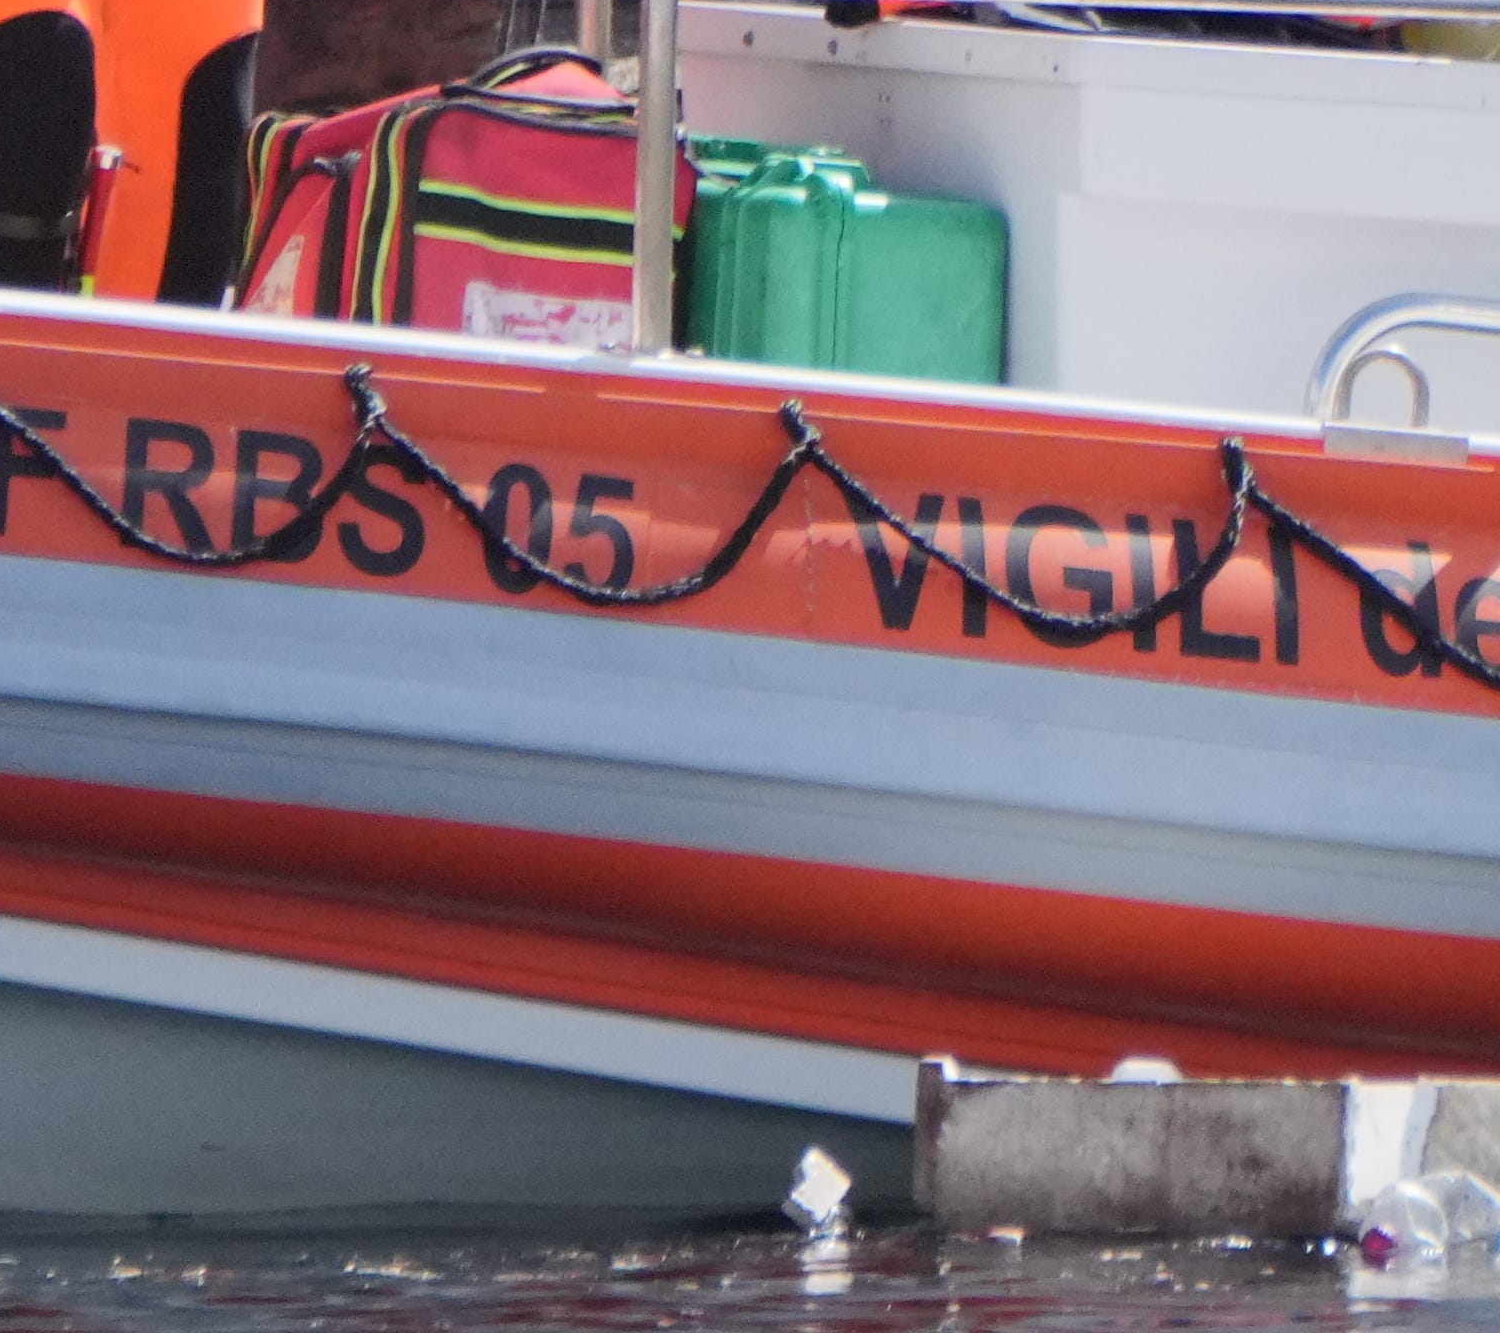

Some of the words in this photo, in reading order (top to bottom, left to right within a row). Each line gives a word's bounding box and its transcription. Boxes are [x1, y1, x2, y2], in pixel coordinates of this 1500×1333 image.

[120, 417, 426, 579] RBS
[484, 463, 636, 605] 05
[842, 493, 1300, 667] VIGILI
